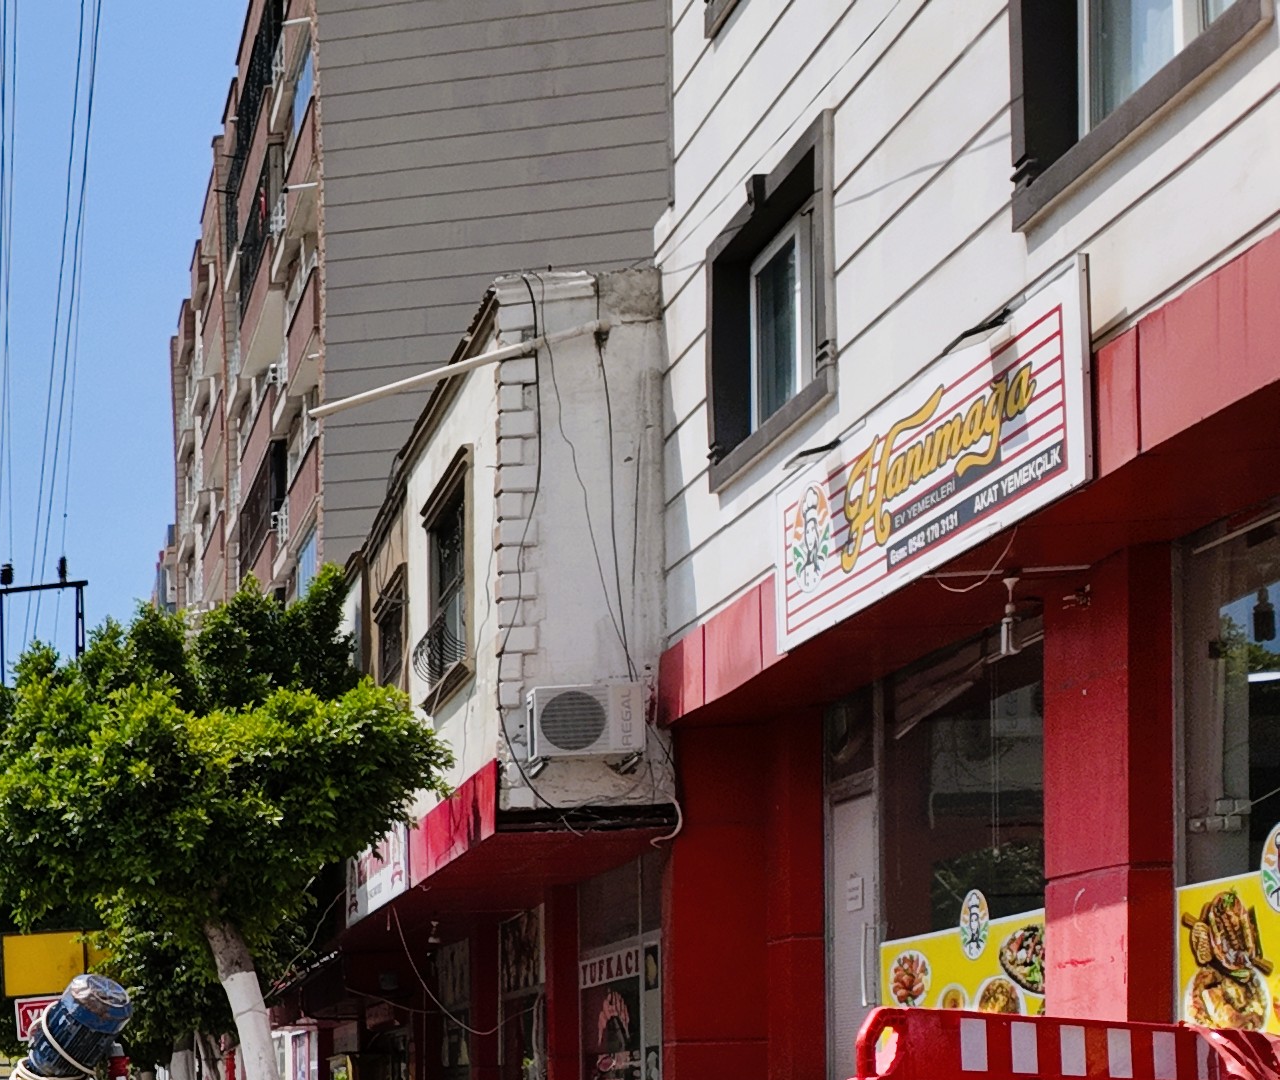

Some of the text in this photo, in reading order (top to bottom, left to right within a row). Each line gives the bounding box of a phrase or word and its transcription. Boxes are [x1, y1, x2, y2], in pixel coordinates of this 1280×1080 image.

[840, 361, 1037, 573] Hanımağa
[974, 446, 1061, 513] AKAT YEMEKÇİLİK
[894, 477, 956, 528] EV YEMEKLERİ
[621, 688, 632, 747] REGAL
[581, 949, 640, 986] YUFKACI
